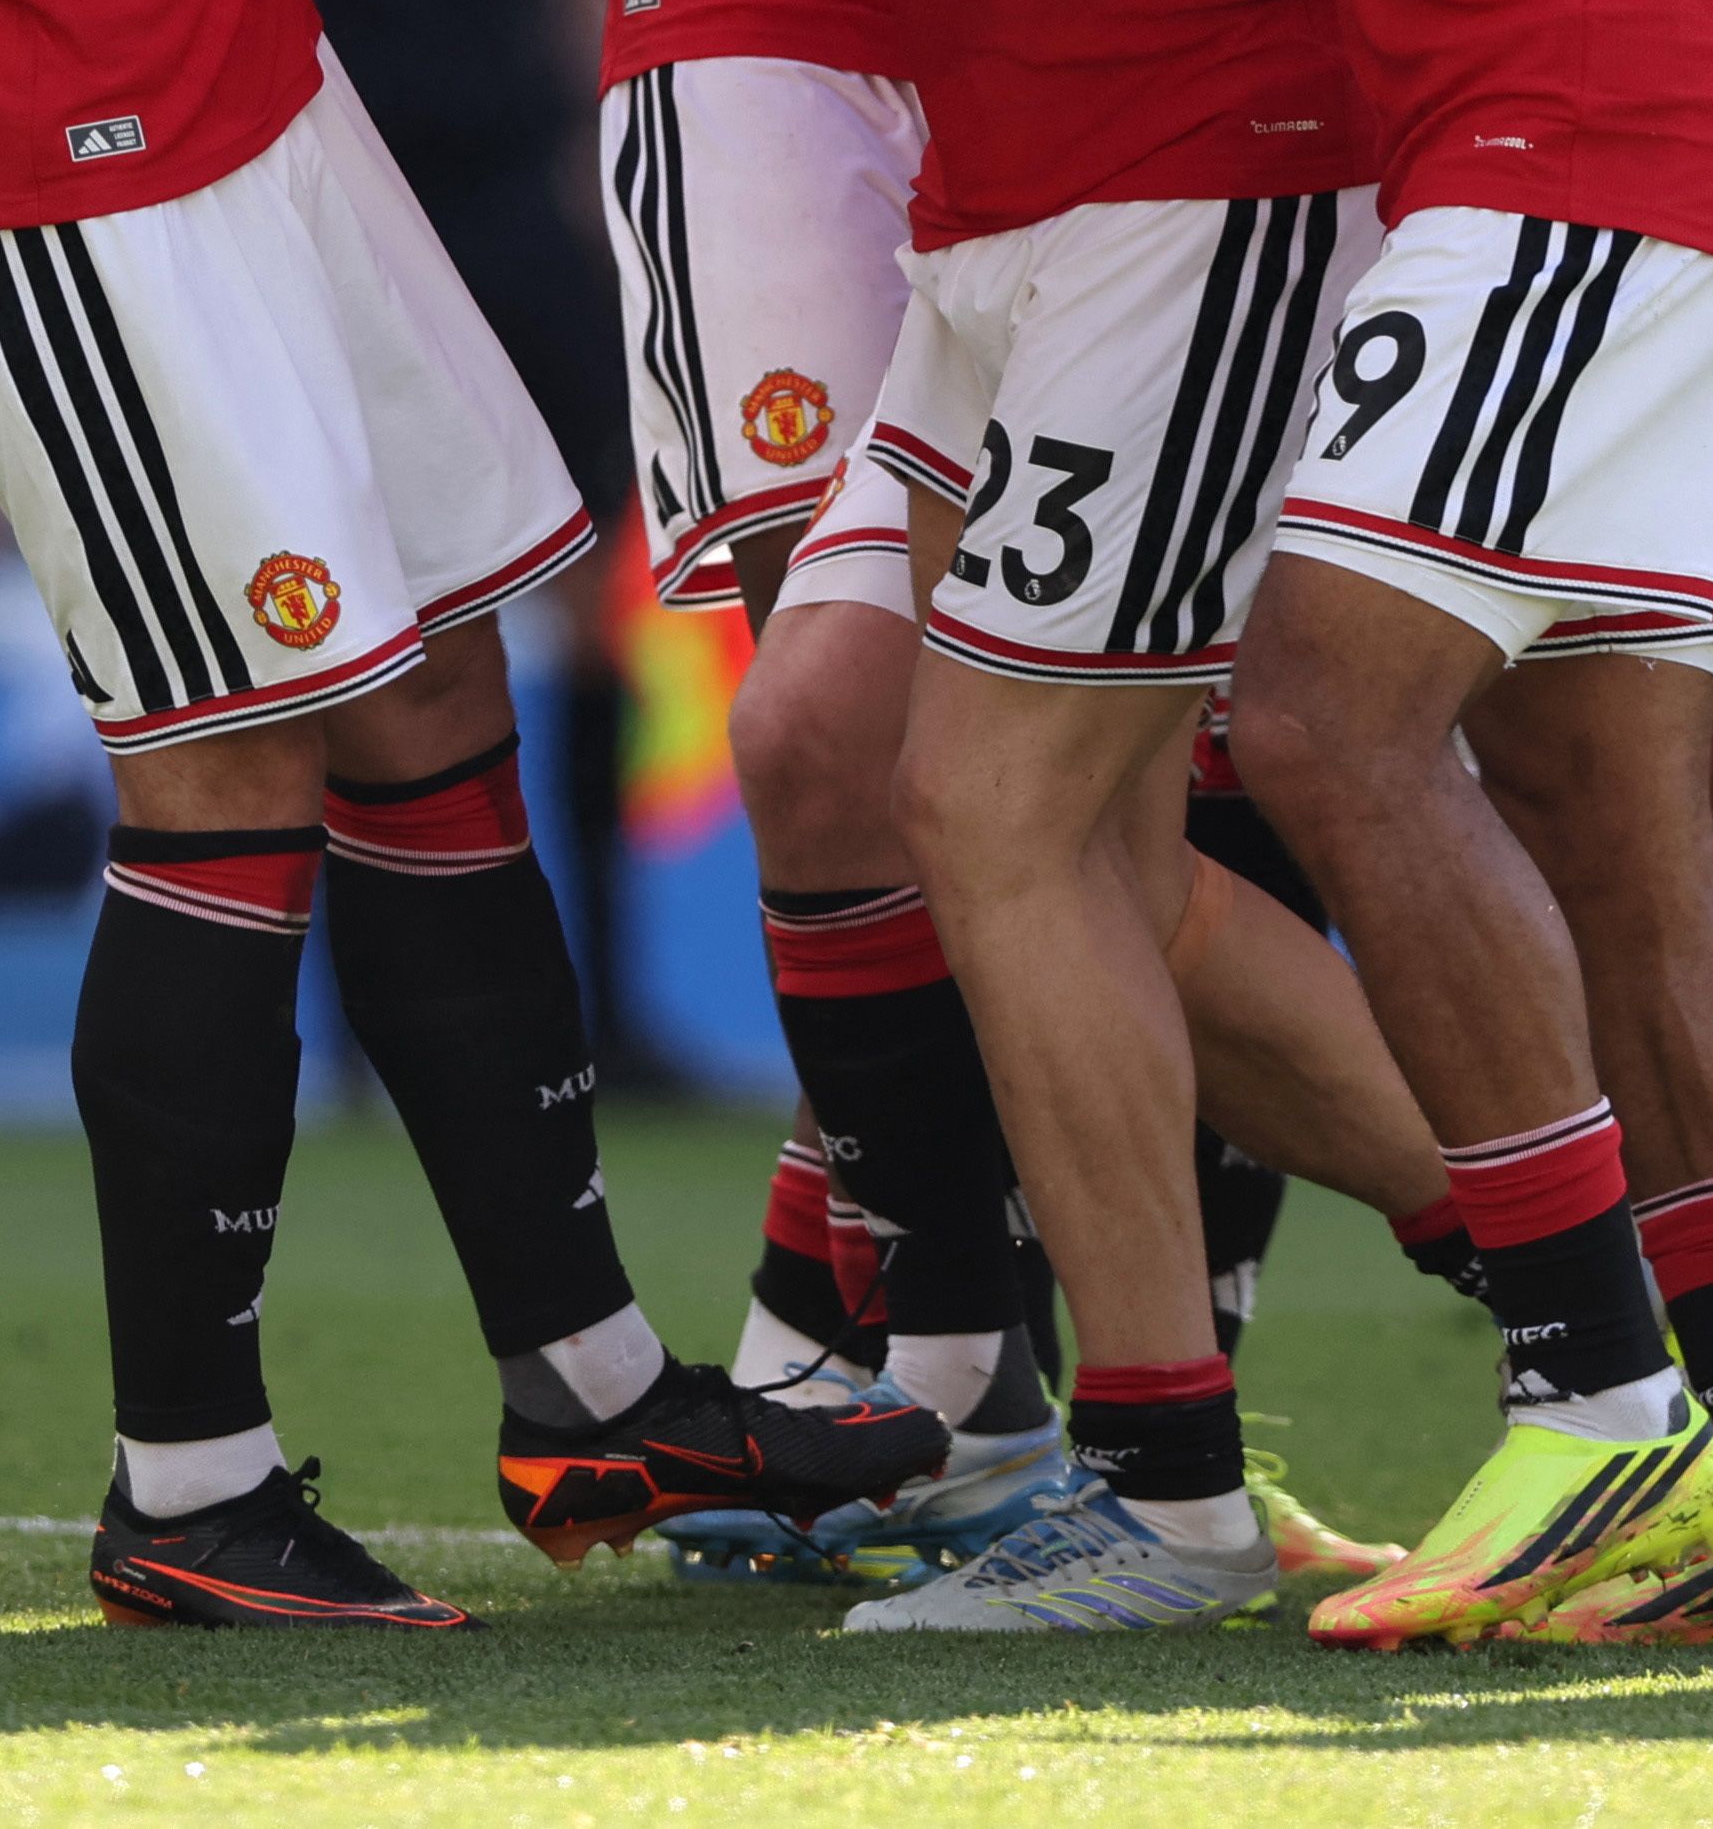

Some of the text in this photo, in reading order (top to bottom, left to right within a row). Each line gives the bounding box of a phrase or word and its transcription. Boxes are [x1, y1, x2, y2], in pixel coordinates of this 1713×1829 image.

[949, 418, 1093, 606] 23
[254, 559, 323, 601] MANCHESTER
[285, 617, 331, 644] UNITED
[210, 1204, 281, 1233] MU
